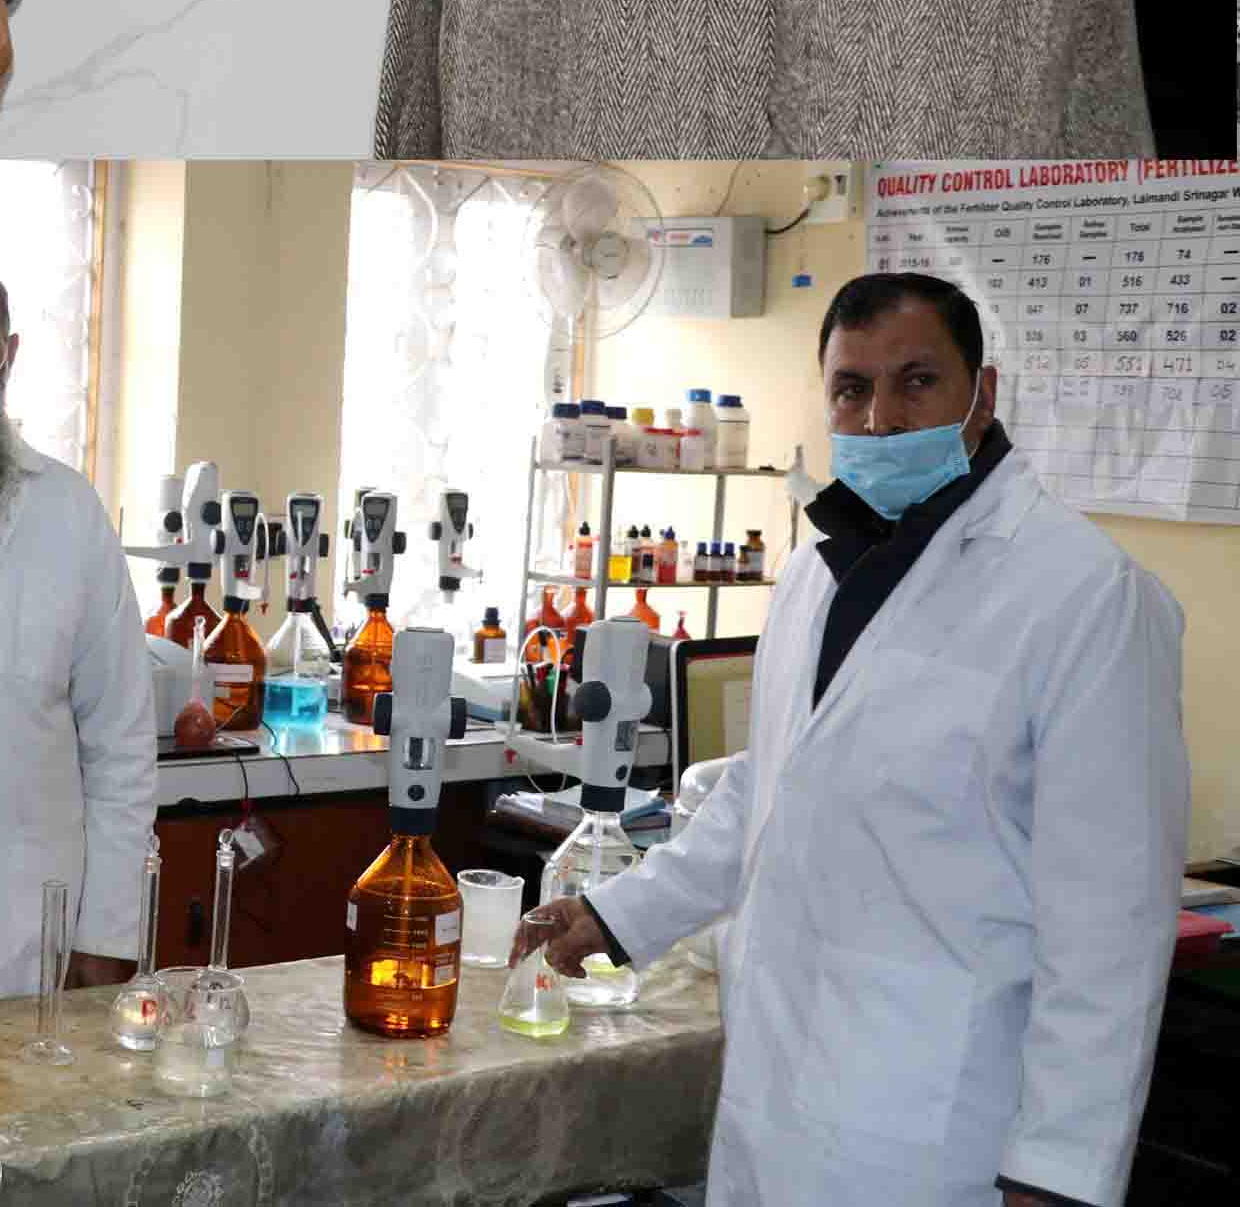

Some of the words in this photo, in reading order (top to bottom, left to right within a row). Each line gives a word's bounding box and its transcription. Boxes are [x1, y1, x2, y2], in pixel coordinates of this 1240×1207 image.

[878, 173, 936, 199] QUALITY
[942, 168, 1014, 193] CONTROL
[1020, 160, 1128, 187] LABORATORY
[1001, 200, 1033, 212] Quality
[1036, 198, 1072, 209] Control
[1183, 189, 1228, 202] Srinagar
[1027, 276, 1048, 289] 413
[1169, 274, 1192, 286] 433
[1075, 303, 1089, 315] 07
[1167, 302, 1190, 314] 716
[1220, 302, 1238, 314] 02
[1220, 329, 1237, 342] 02
